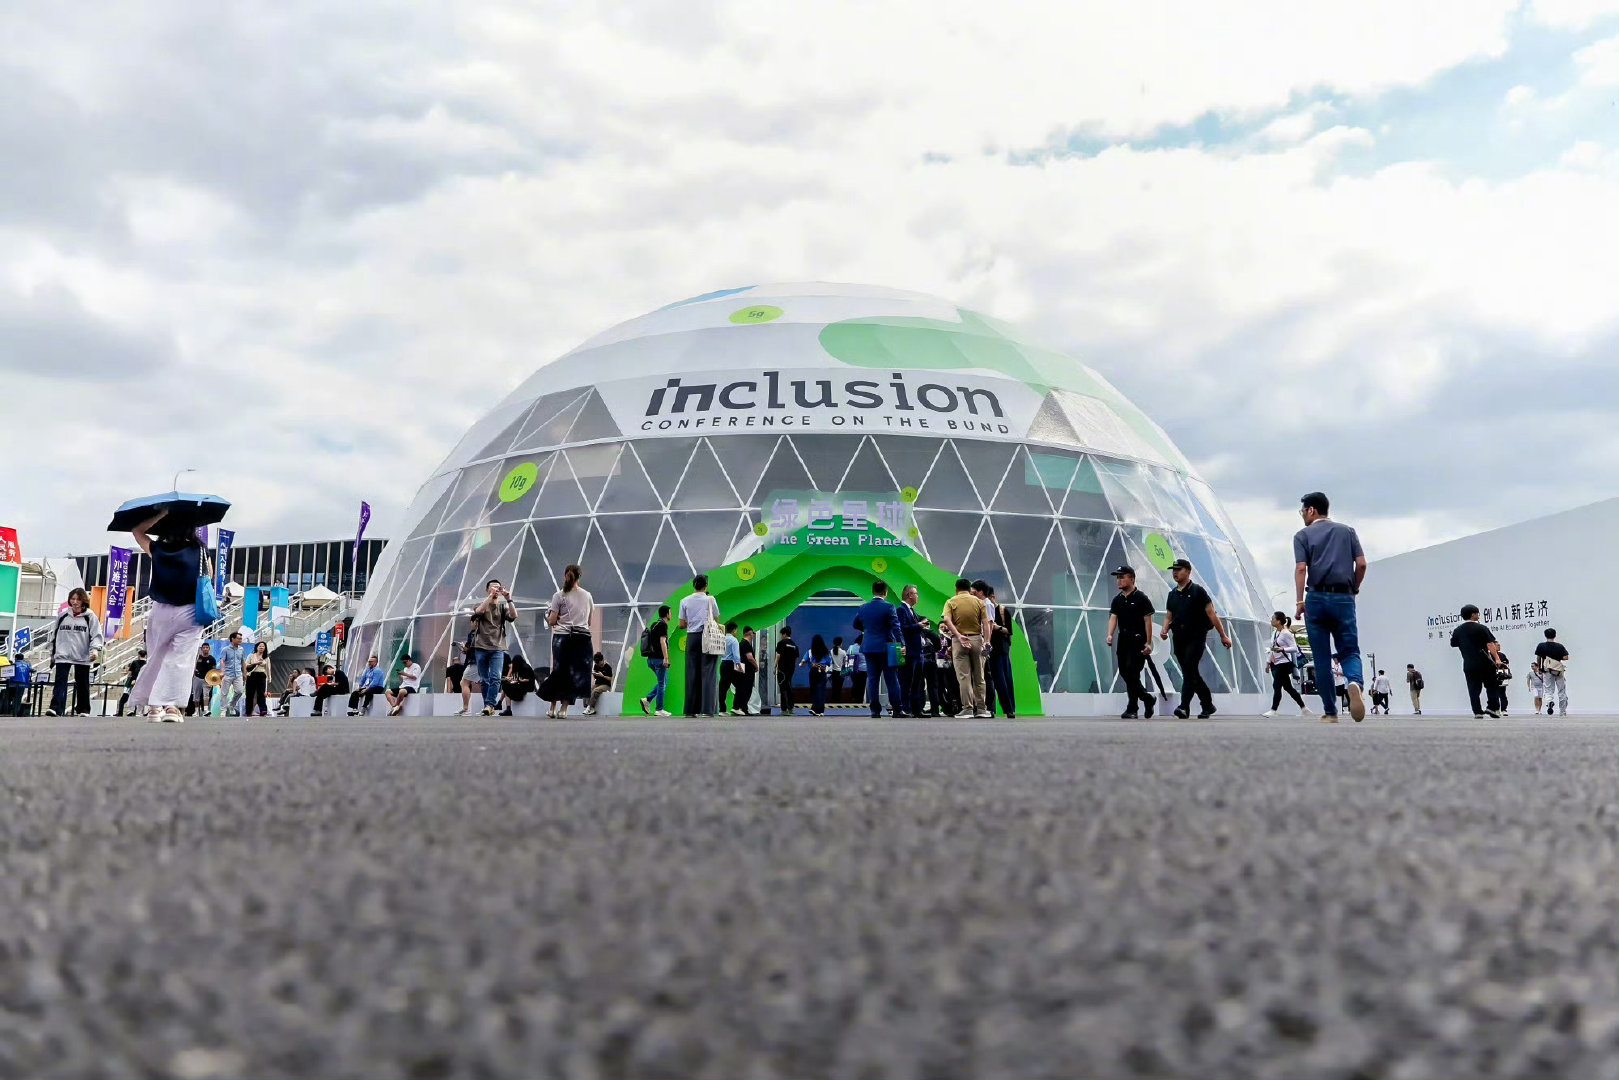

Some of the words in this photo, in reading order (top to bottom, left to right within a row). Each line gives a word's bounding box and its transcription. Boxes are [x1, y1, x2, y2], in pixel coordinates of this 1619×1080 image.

[645, 371, 1004, 418] inclusion
[640, 415, 811, 431] CONFERENCE
[832, 415, 865, 426] ON
[883, 415, 930, 429] THE
[947, 419, 1009, 434] BUND
[509, 475, 528, 491] 10g
[769, 498, 906, 532] 绿色星球
[806, 533, 850, 545] Green
[858, 534, 907, 547] Planet
[1478, 599, 1549, 624] 创AI新经济
